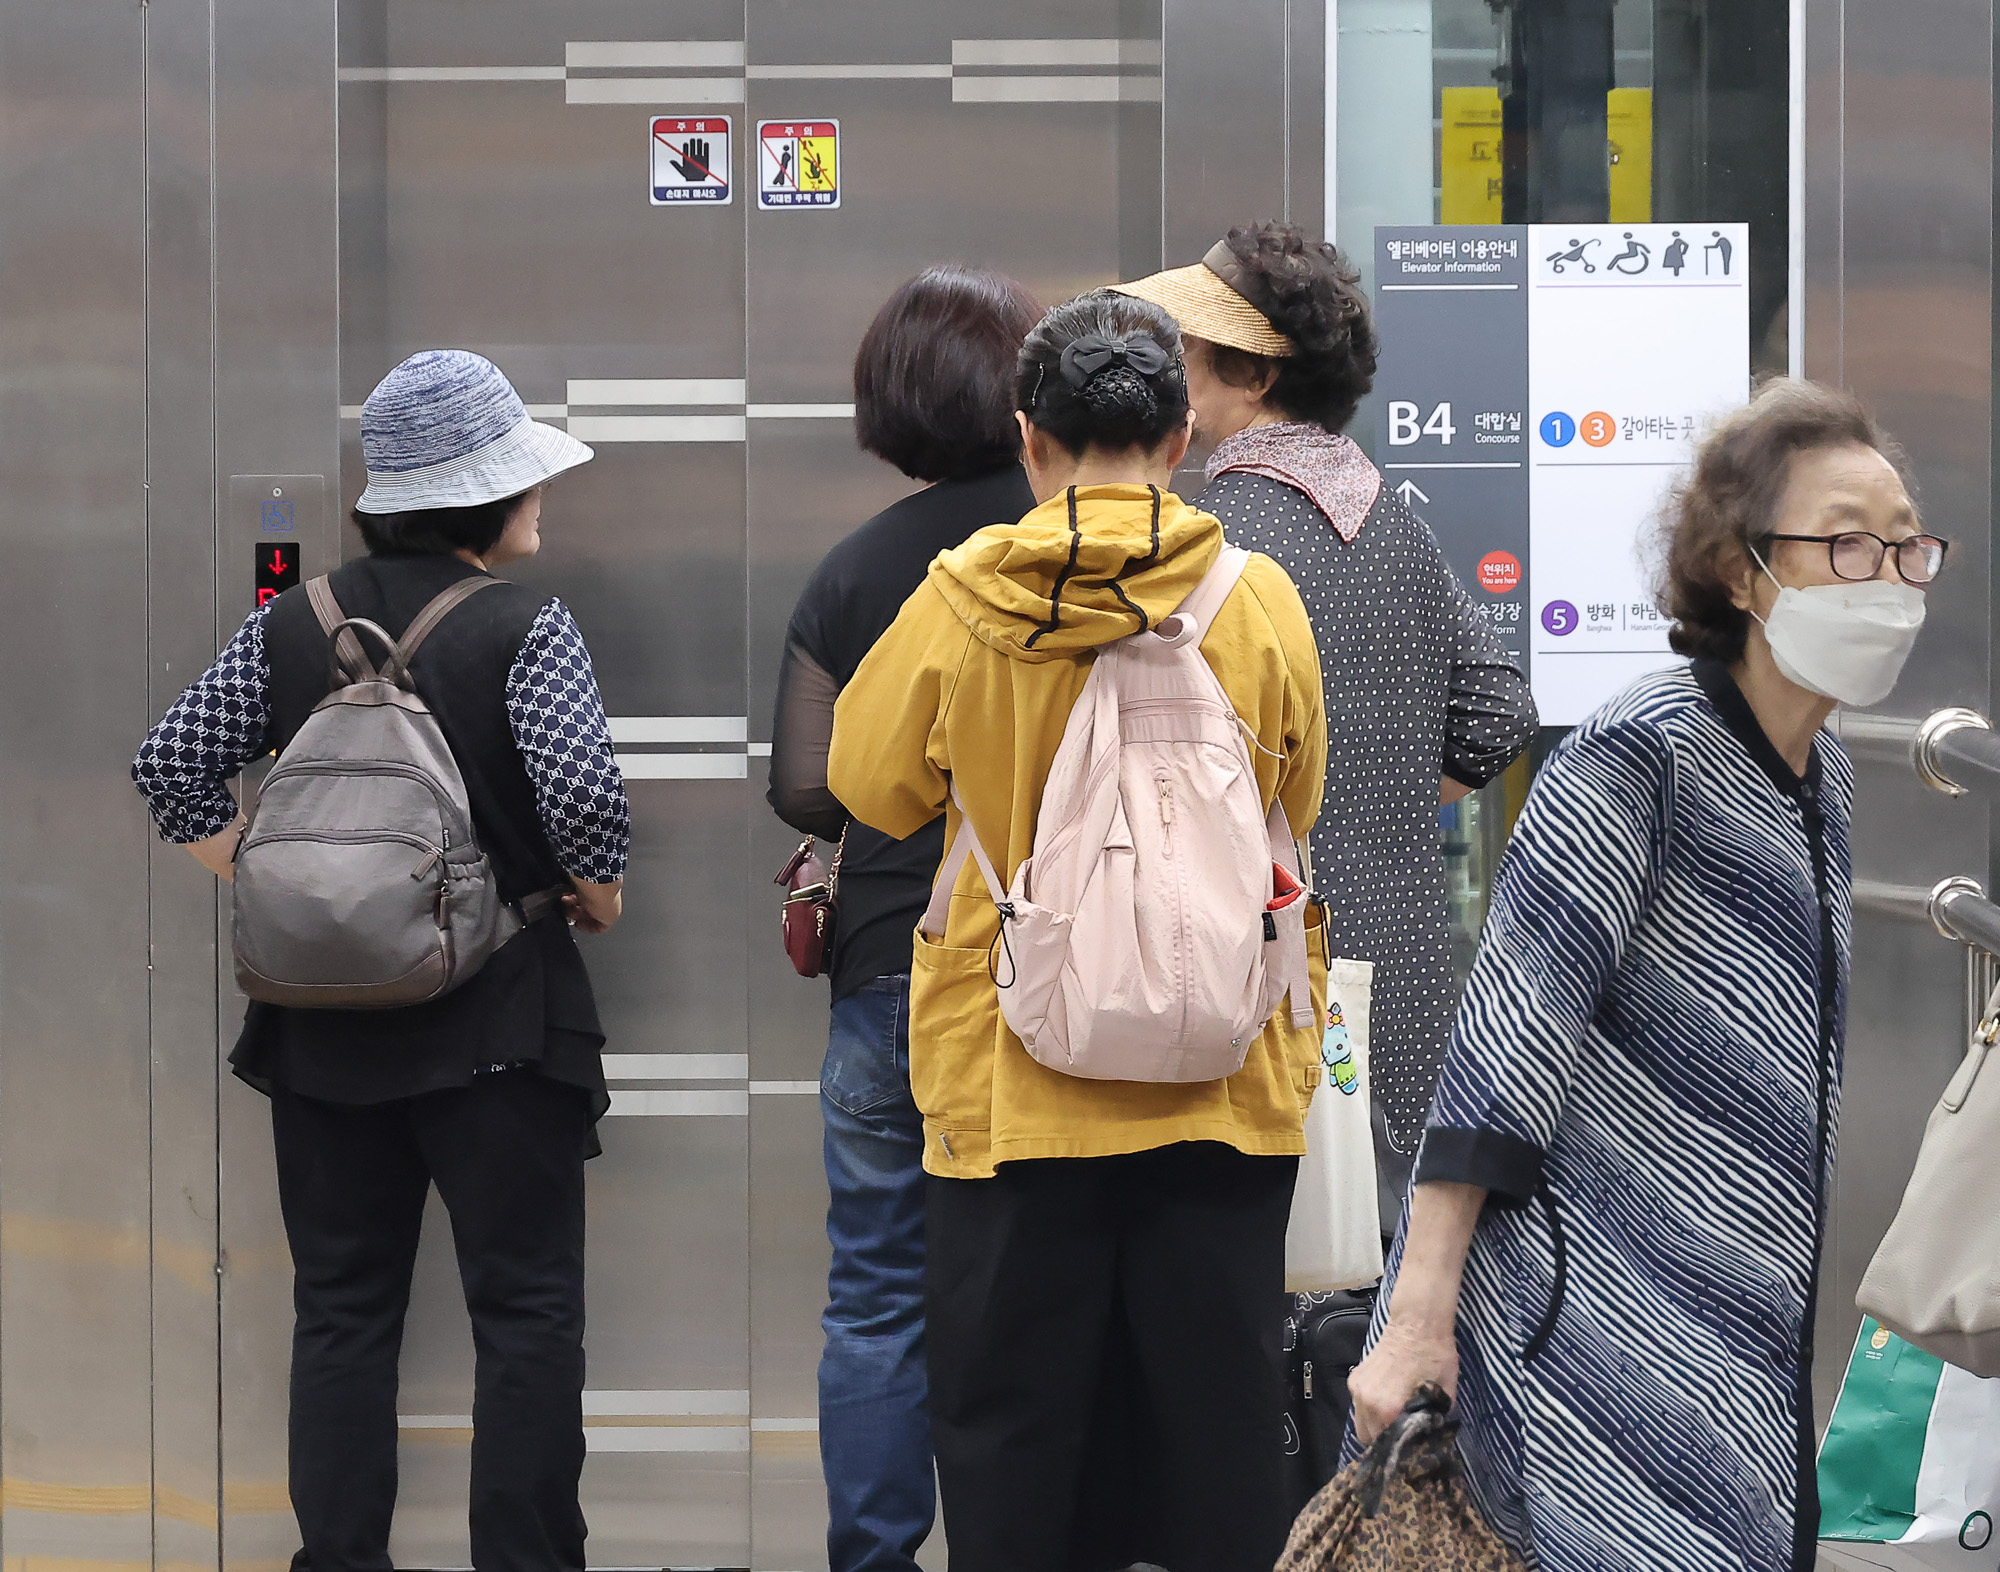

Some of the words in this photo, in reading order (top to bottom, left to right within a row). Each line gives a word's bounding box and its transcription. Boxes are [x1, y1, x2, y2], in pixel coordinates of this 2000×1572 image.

[665, 189, 690, 199] 손대지
[693, 189, 717, 199] 마시오
[1386, 240, 1456, 260] 엘리베이터
[1461, 240, 1518, 259] 이용안내
[1402, 261, 1442, 273] Elevator
[1444, 261, 1501, 273] Information
[1388, 400, 1456, 446] B4
[1474, 412, 1521, 431] 대합실
[1622, 416, 1678, 441] 갈아타는
[1681, 416, 1695, 441] 곳
[1475, 433, 1520, 444] Concourse
[1483, 563, 1514, 576] 현위치
[1482, 577, 1494, 585] You
[1551, 607, 1568, 630] 5
[1587, 603, 1616, 621] 방화
